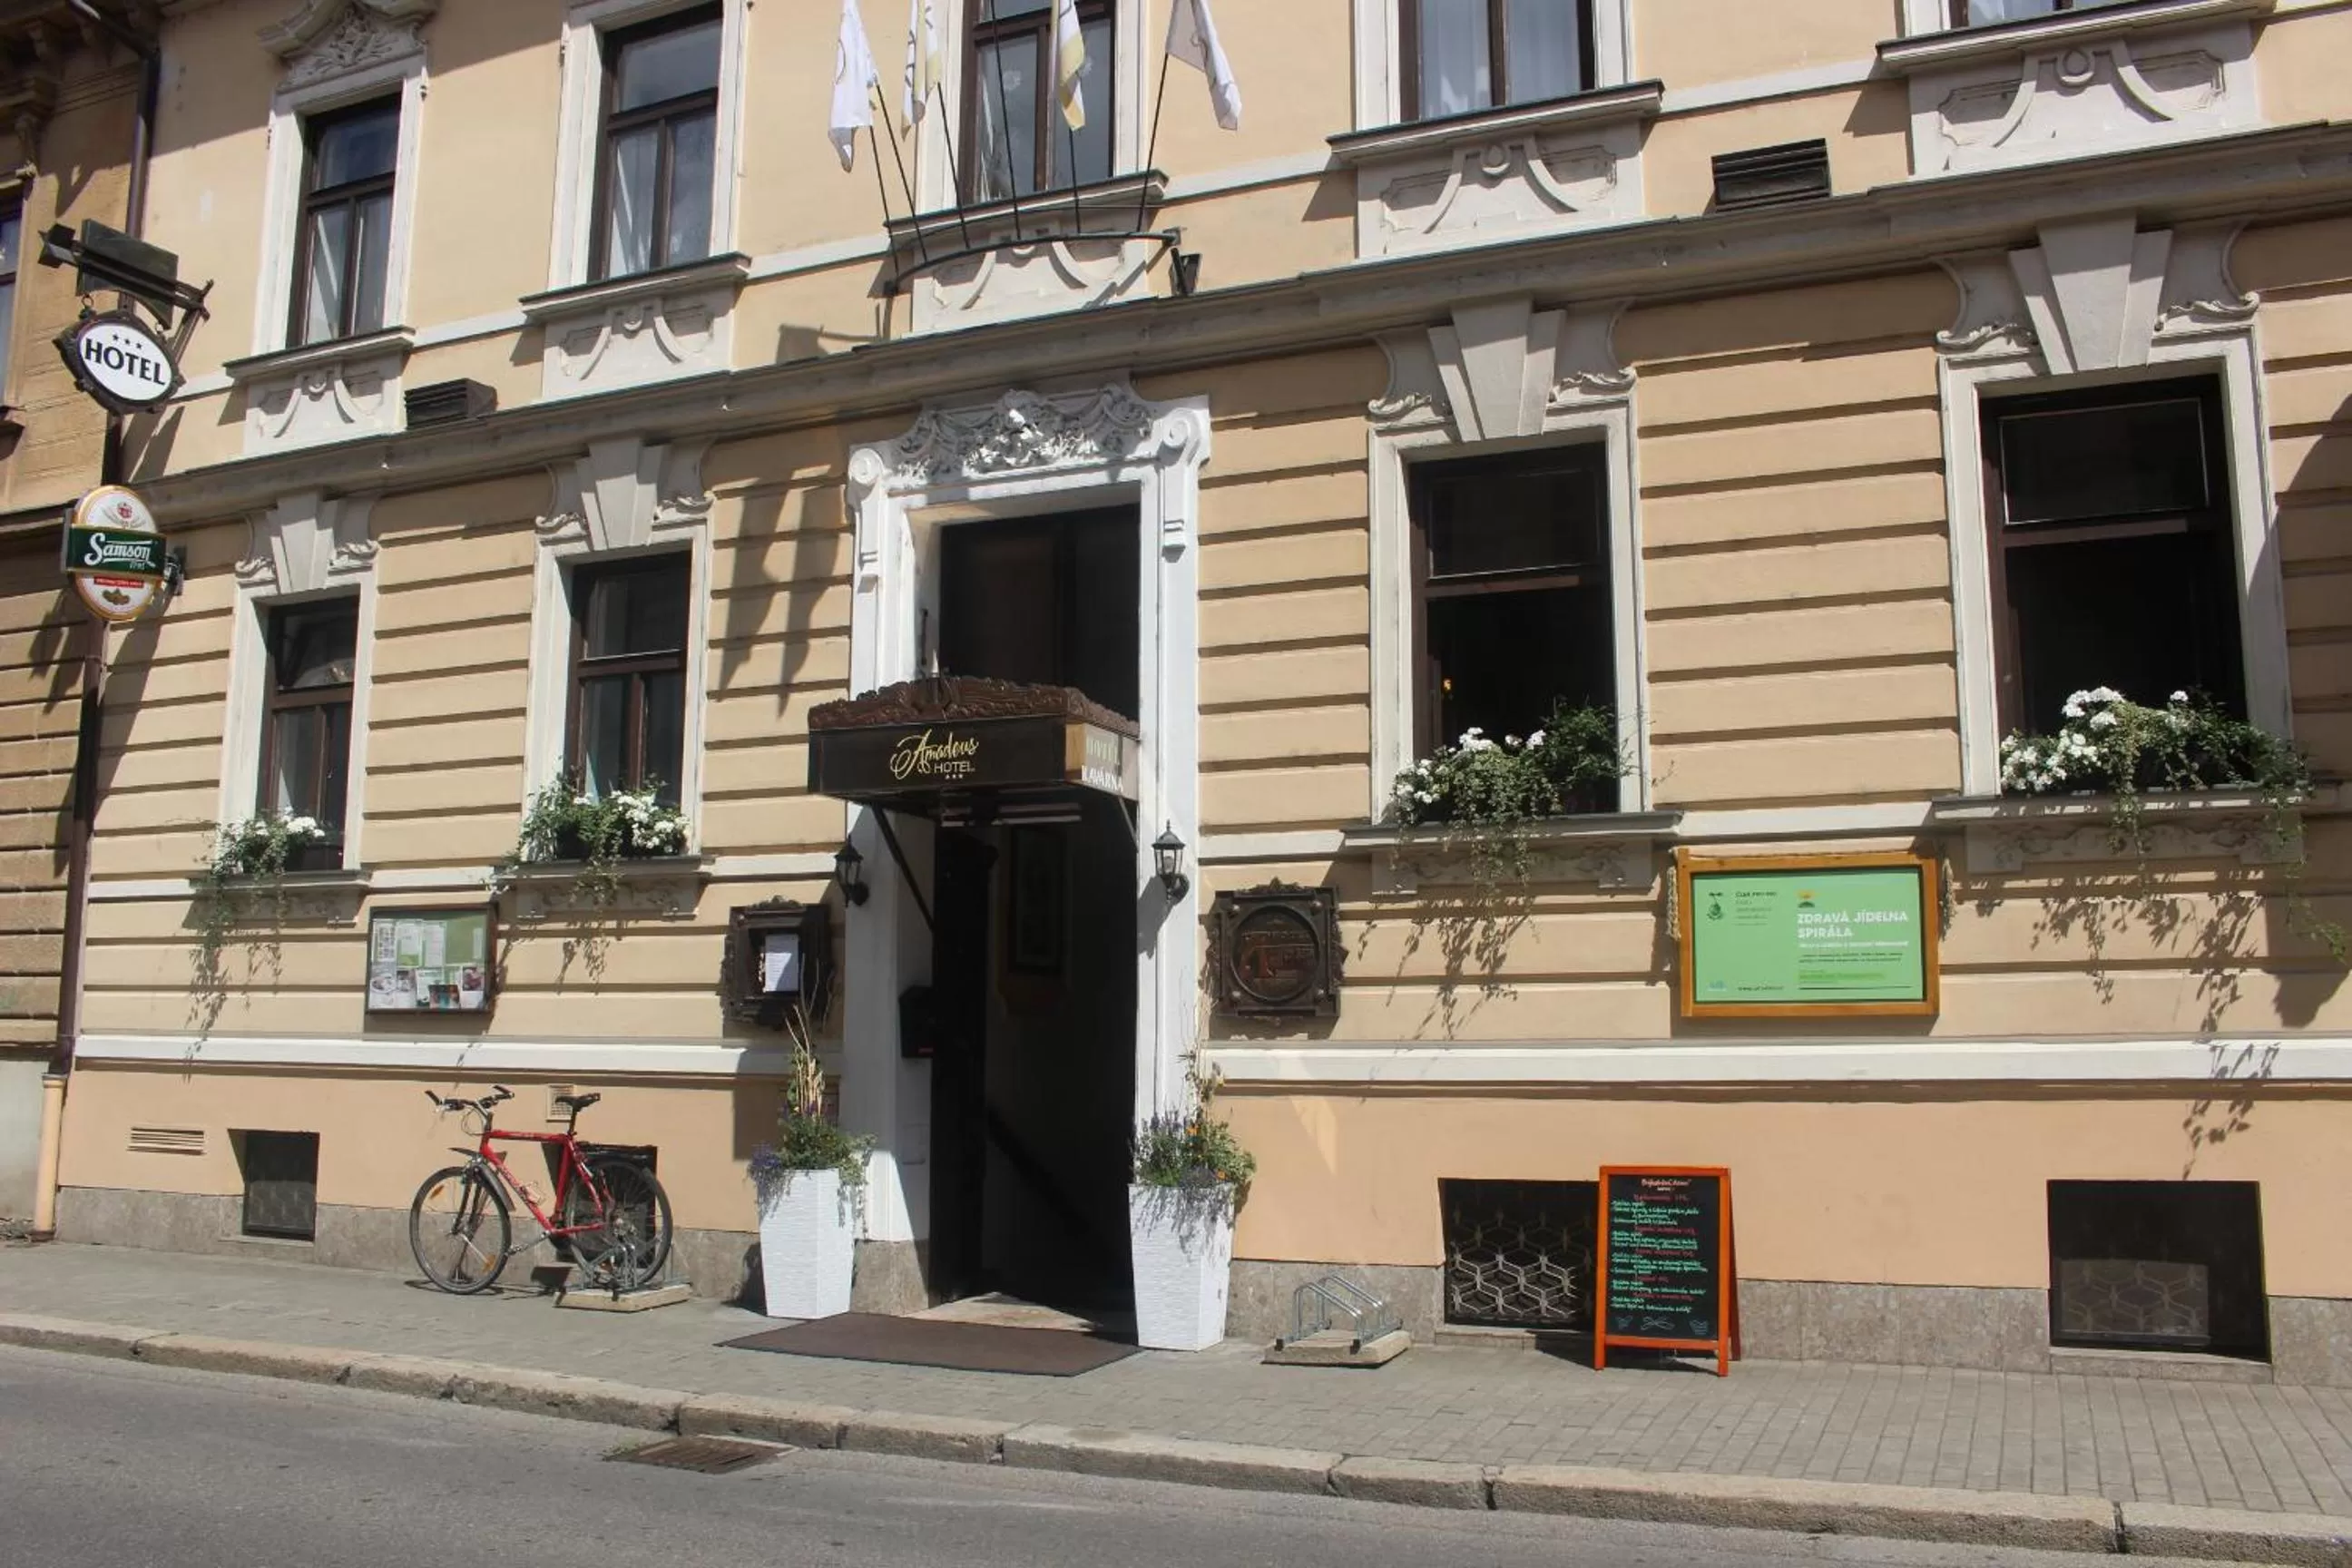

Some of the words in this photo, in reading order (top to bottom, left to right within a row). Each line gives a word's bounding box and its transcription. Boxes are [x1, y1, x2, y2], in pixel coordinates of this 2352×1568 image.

[84, 338, 166, 386] HOTEL
[84, 532, 152, 566] Samson
[889, 729, 980, 780] Amadeus
[934, 761, 975, 774] HOTEL
[1798, 911, 1849, 924] ZDRAVÁ
[1854, 909, 1908, 923] JÍDELNA
[1798, 926, 1853, 937] SPIRÁLA
